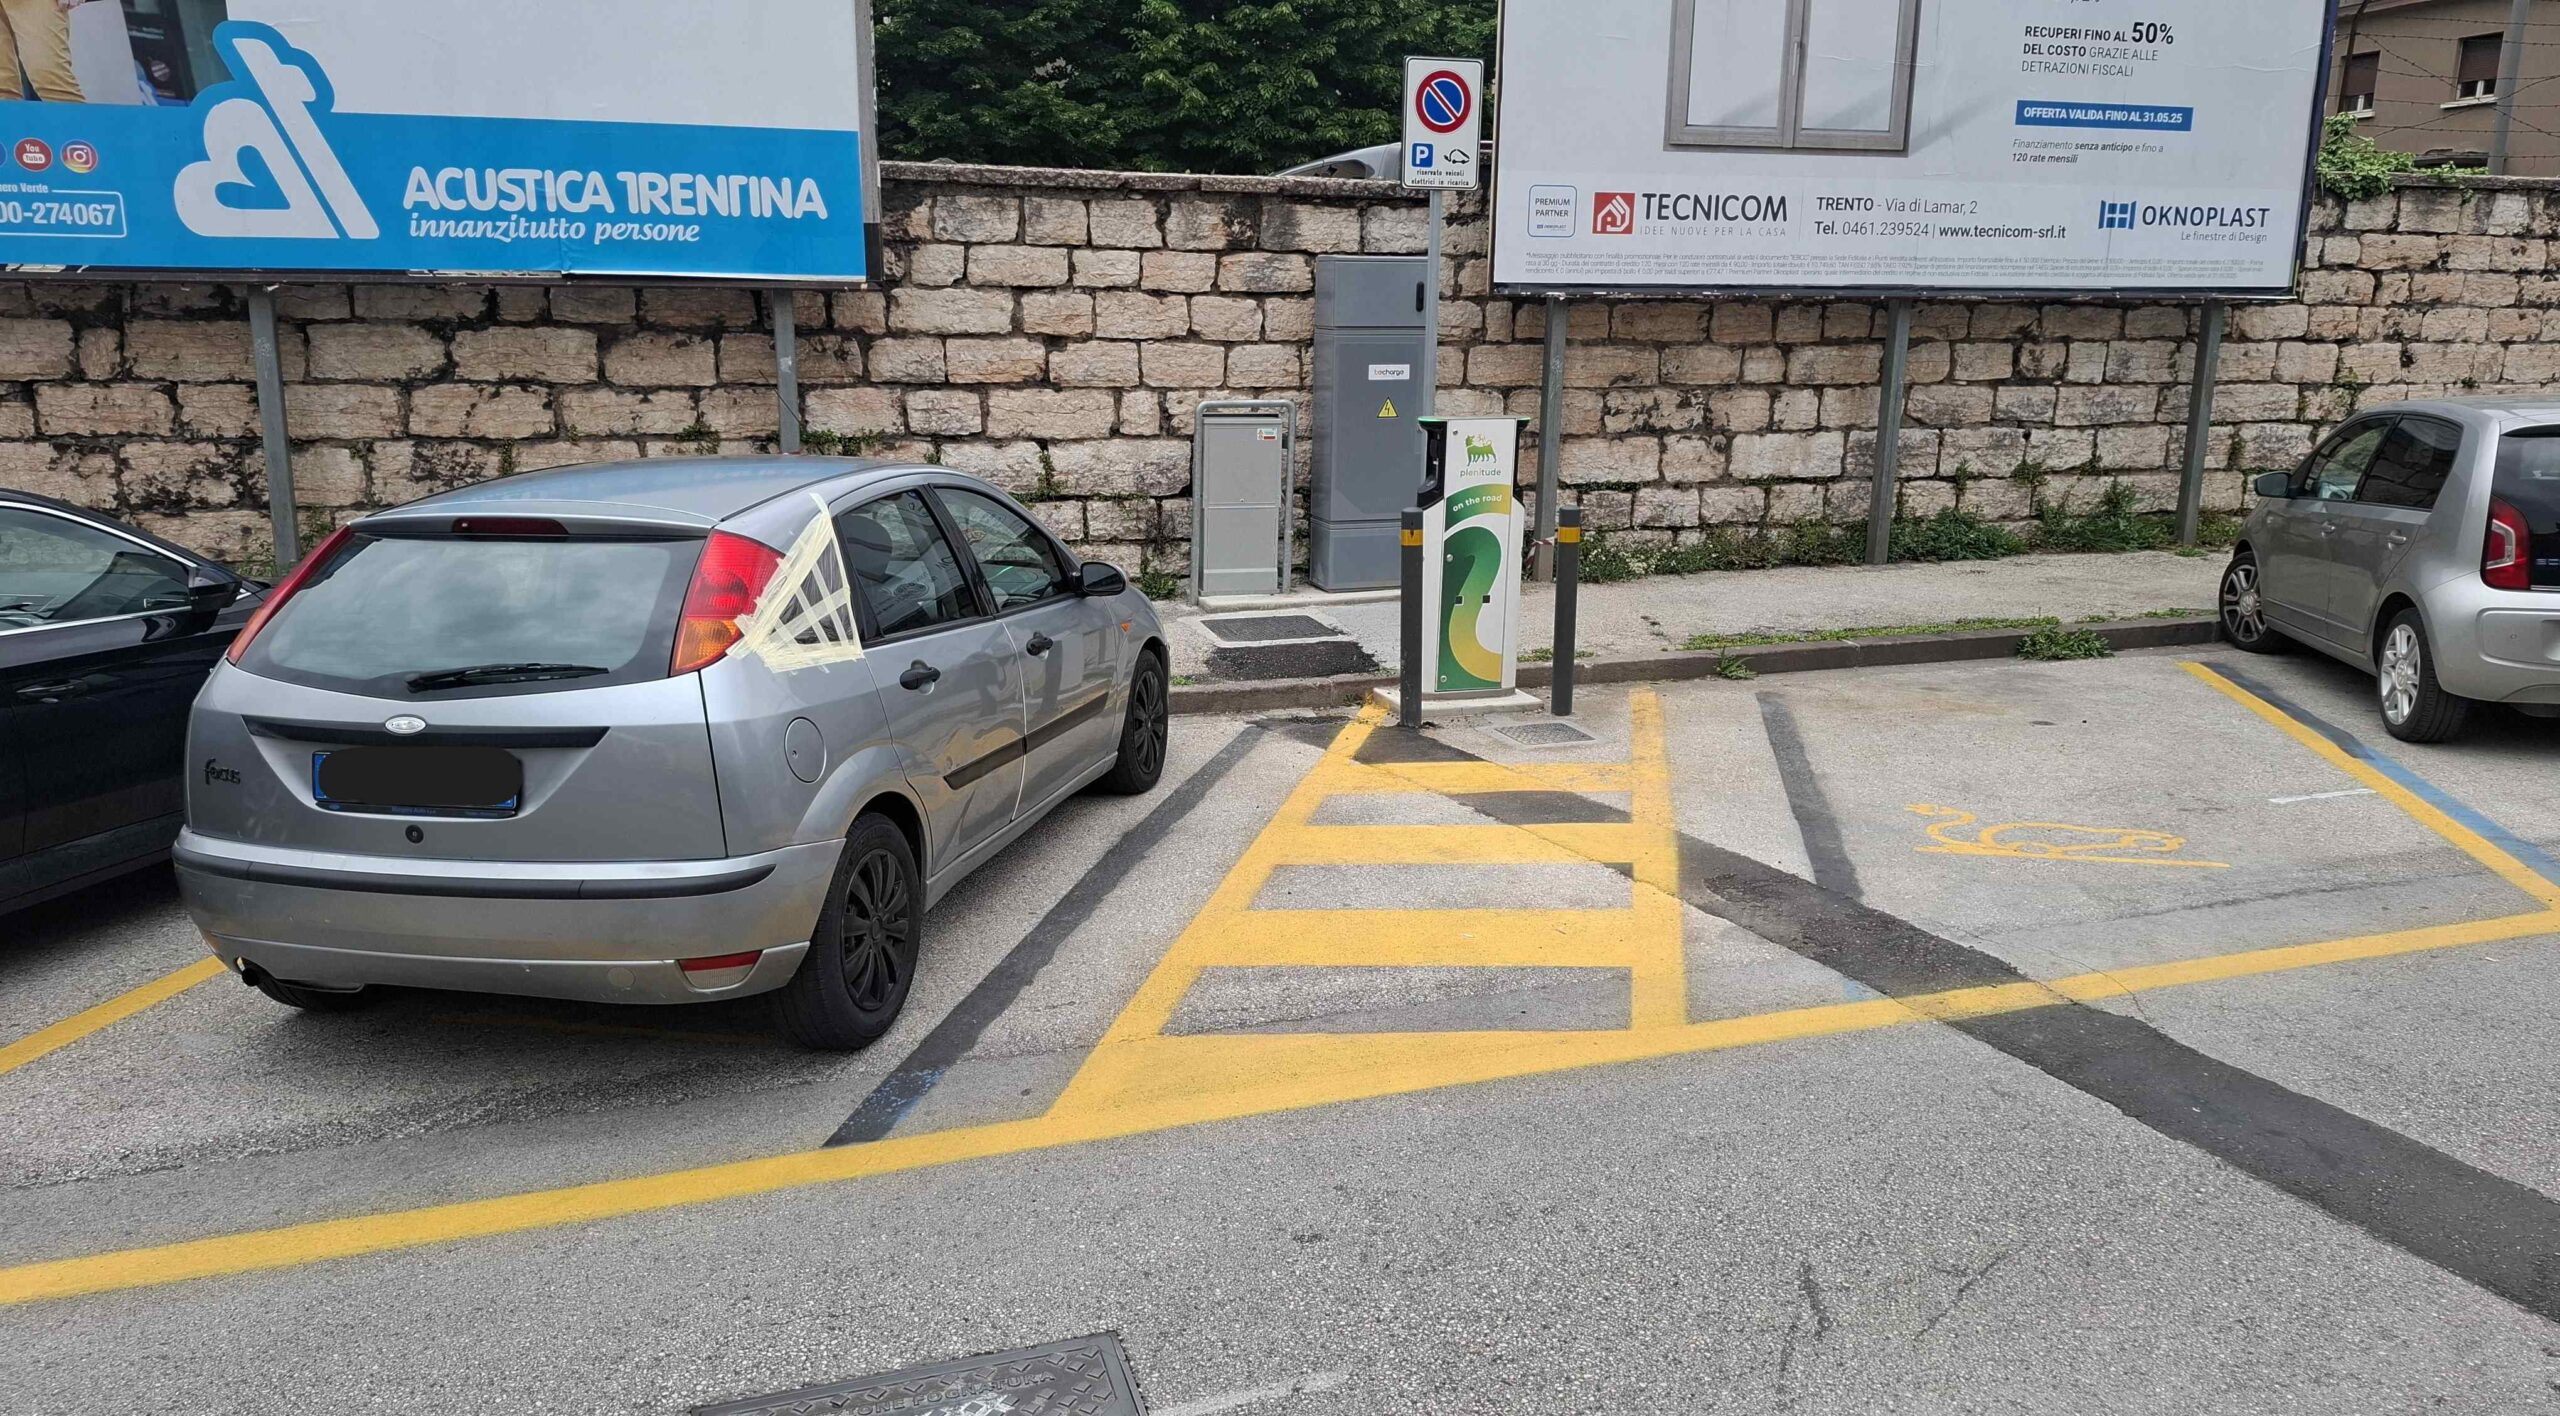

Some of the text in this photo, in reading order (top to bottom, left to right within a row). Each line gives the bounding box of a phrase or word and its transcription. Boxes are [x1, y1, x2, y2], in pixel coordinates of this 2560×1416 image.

[2024, 21, 2174, 44] RECUPERI FINO AL 50%
[2023, 43, 2159, 61] DEL COSTO GRAZIE ALLE
[2021, 60, 2134, 77] DETRAZIONI FISCALI
[2023, 106, 2183, 124] OFFERTA VALIDA FINO AL 31.05.25
[2012, 138, 2164, 154] Finanziamento senza anticipo e fino a
[2012, 152, 2078, 164] 120 rate mensili
[19, 183, 49, 193] Verde
[403, 166, 828, 220] ACUSTICA TRENTINA
[1534, 197, 1571, 206] PREMIUM
[1642, 193, 1788, 222] TECNICOM
[1816, 197, 1874, 211] TRENTO
[1885, 198, 1905, 212] Via
[1909, 198, 1921, 212] di
[1924, 199, 1966, 216] Lamar,
[1969, 200, 1978, 214] 2
[1535, 208, 1569, 217] PARTNER
[2142, 205, 2270, 228] OKNOPLAST
[409, 212, 700, 246] innanzitutto persone
[1639, 226, 1787, 237] IDEE NUOVE PER LA CASA
[1814, 221, 1838, 235] Tel.
[1842, 221, 1929, 237] 0461.239524
[1939, 224, 2067, 239] www.tecnicom-srl.it
[2181, 231, 2267, 244] Le finestre di Design
[1460, 468, 1502, 478] plenitude
[1452, 494, 1503, 512] on the road
[911, 1371, 1056, 1406] FOGNATURA
